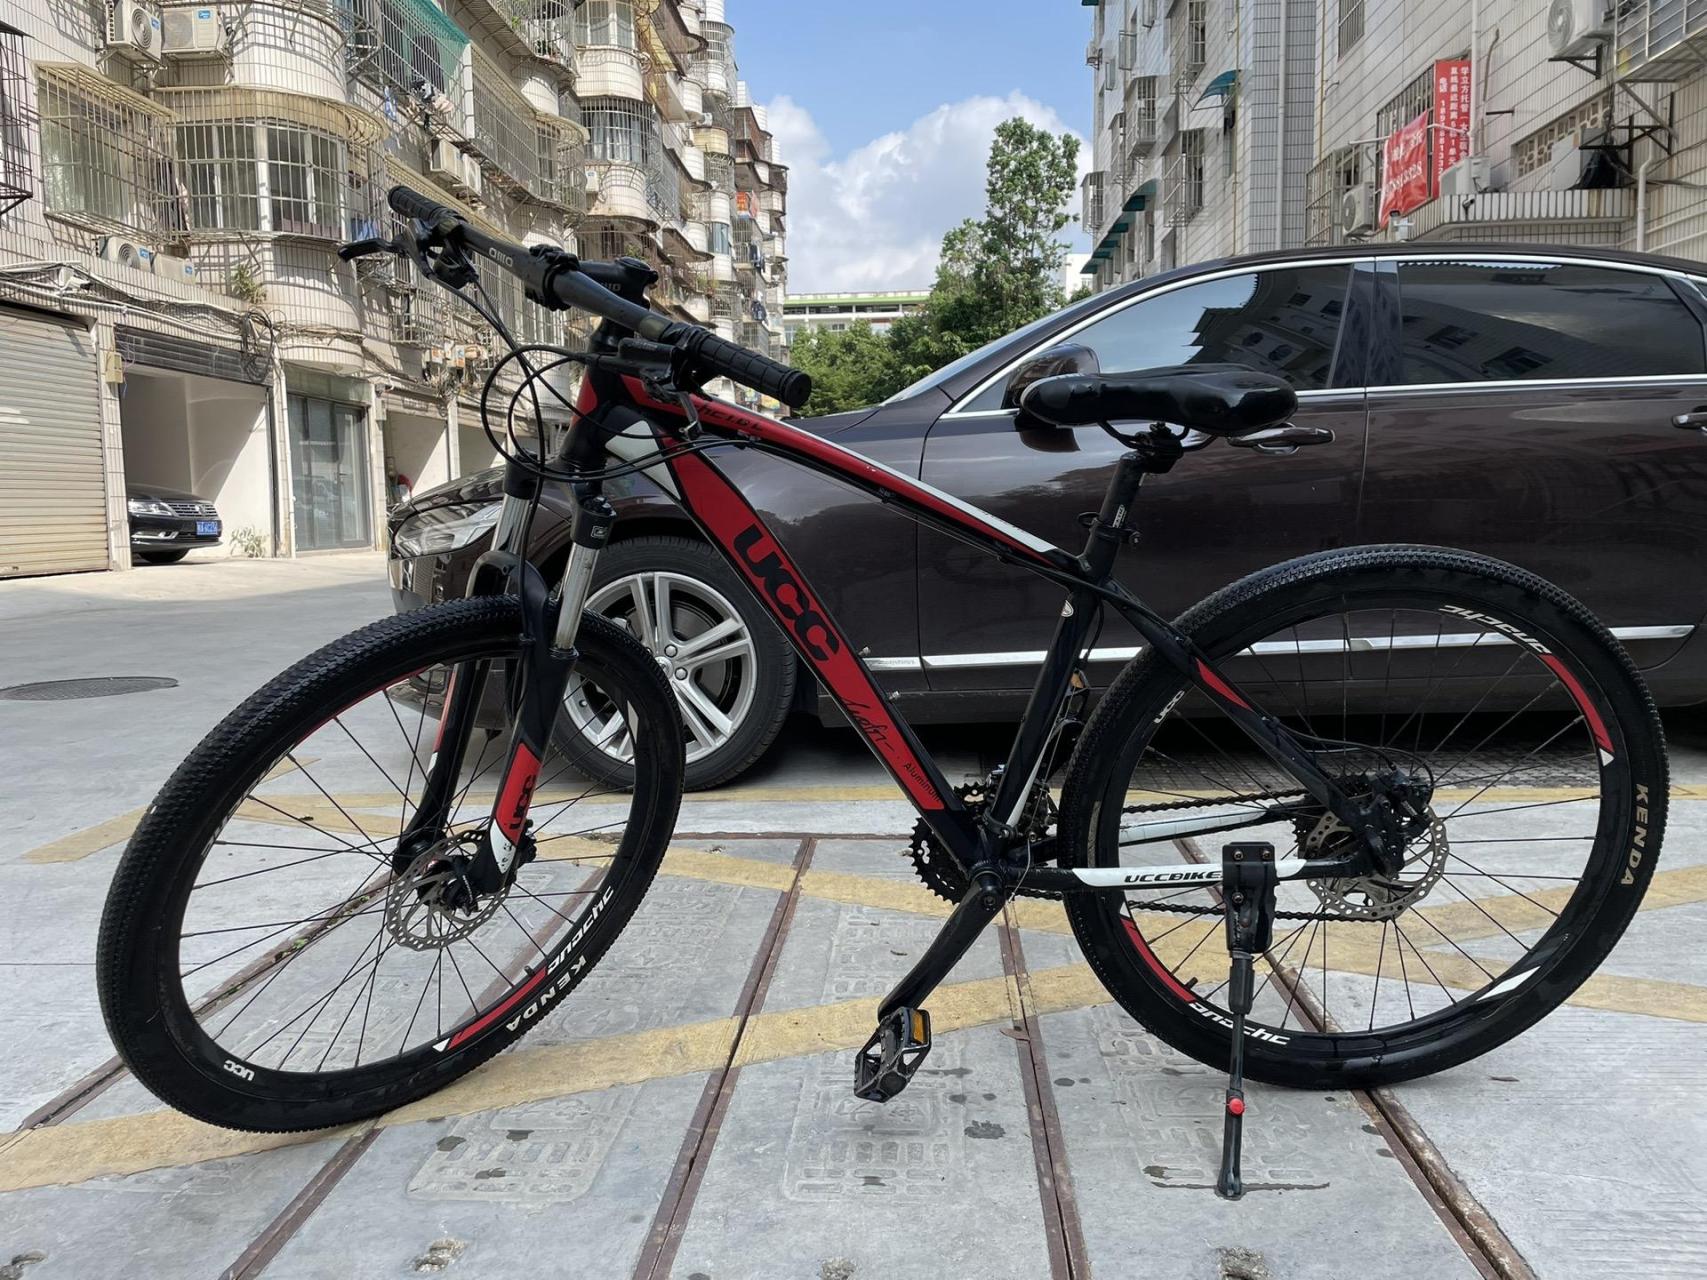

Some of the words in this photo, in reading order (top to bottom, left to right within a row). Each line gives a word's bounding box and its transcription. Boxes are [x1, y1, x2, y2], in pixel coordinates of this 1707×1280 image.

[733, 523, 840, 662] UCC
[1620, 782, 1649, 886] KENDA
[505, 954, 588, 1032] KENDA
